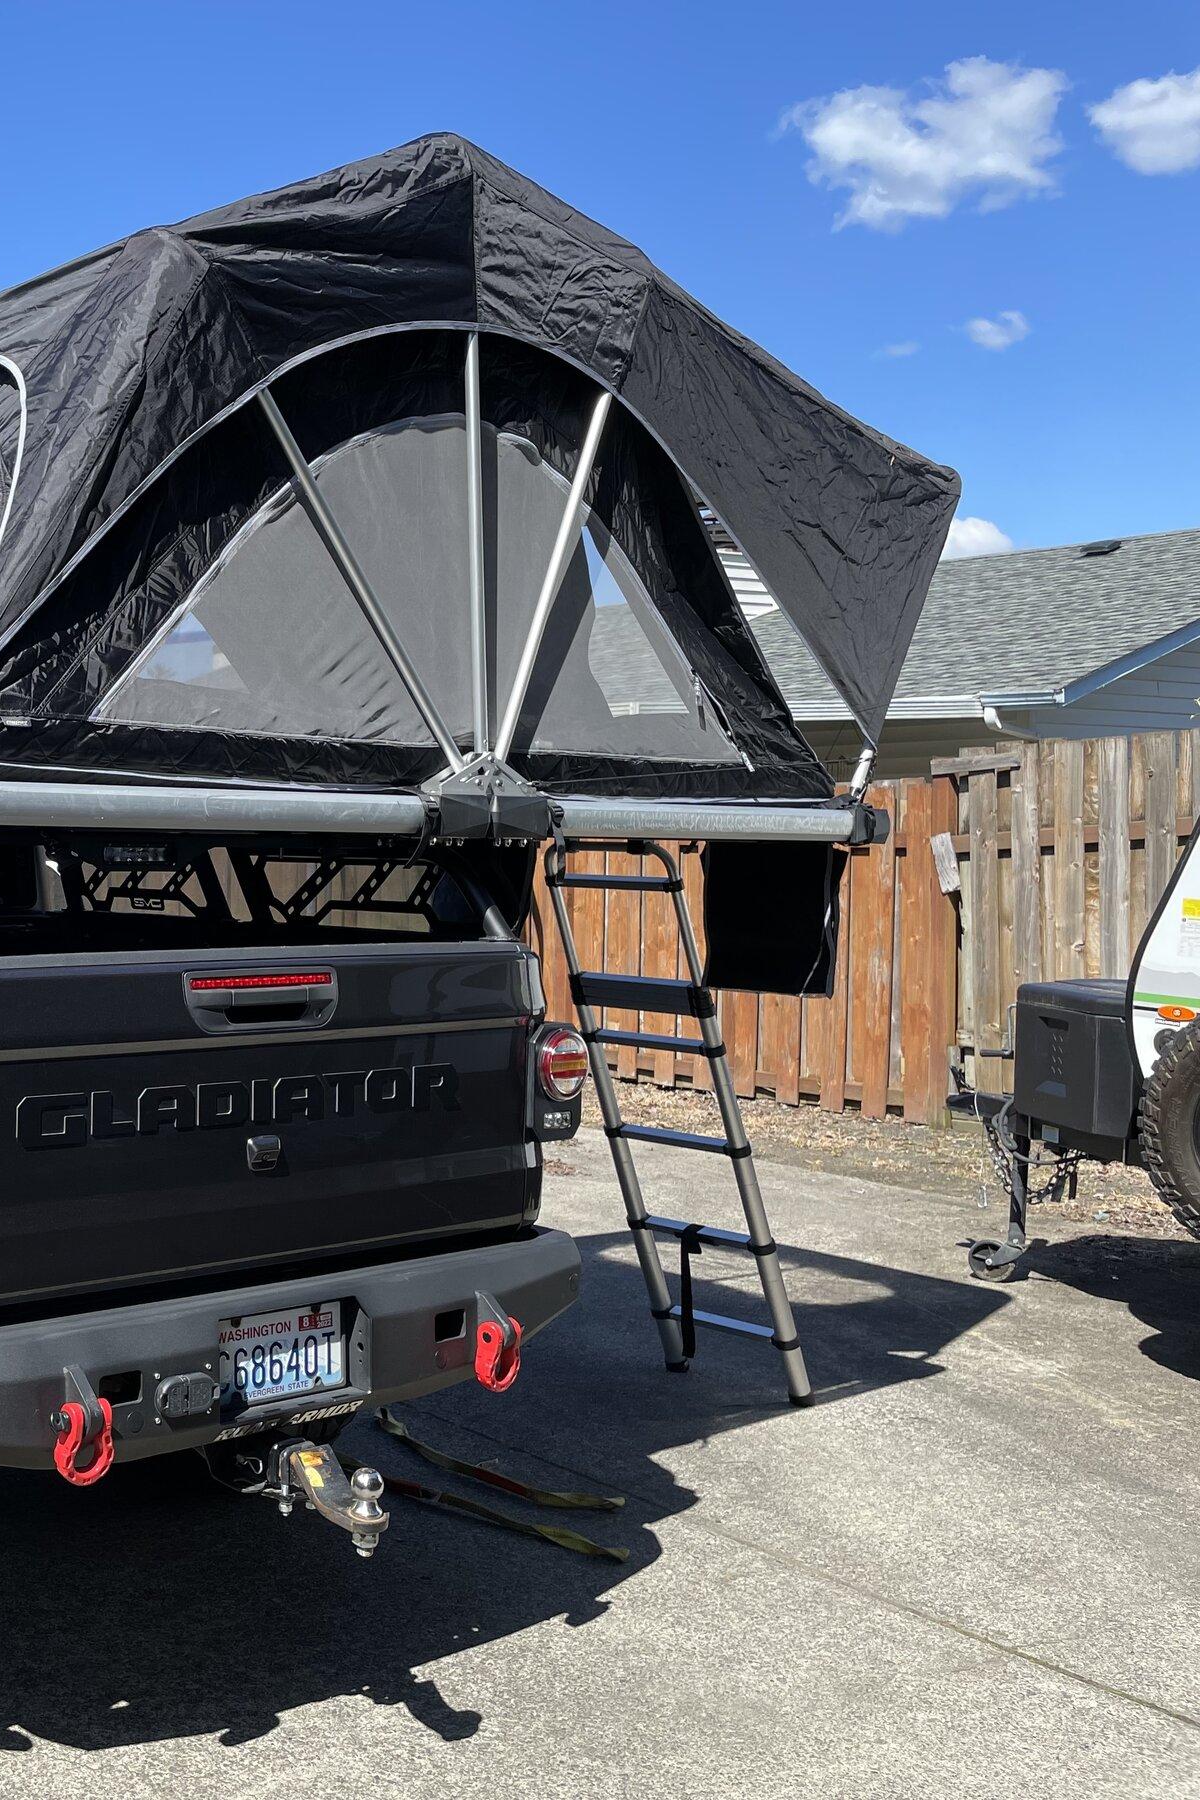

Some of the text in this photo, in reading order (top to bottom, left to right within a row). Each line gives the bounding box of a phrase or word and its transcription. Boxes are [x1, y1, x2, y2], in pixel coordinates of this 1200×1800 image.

[15, 1062, 461, 1150] GLADIATOR
[219, 1321, 292, 1344] WASHINGTON
[219, 1331, 335, 1394] C68640T
[244, 1380, 309, 1400] EVERGREEN STATE
[282, 1400, 364, 1426] ARMOR
